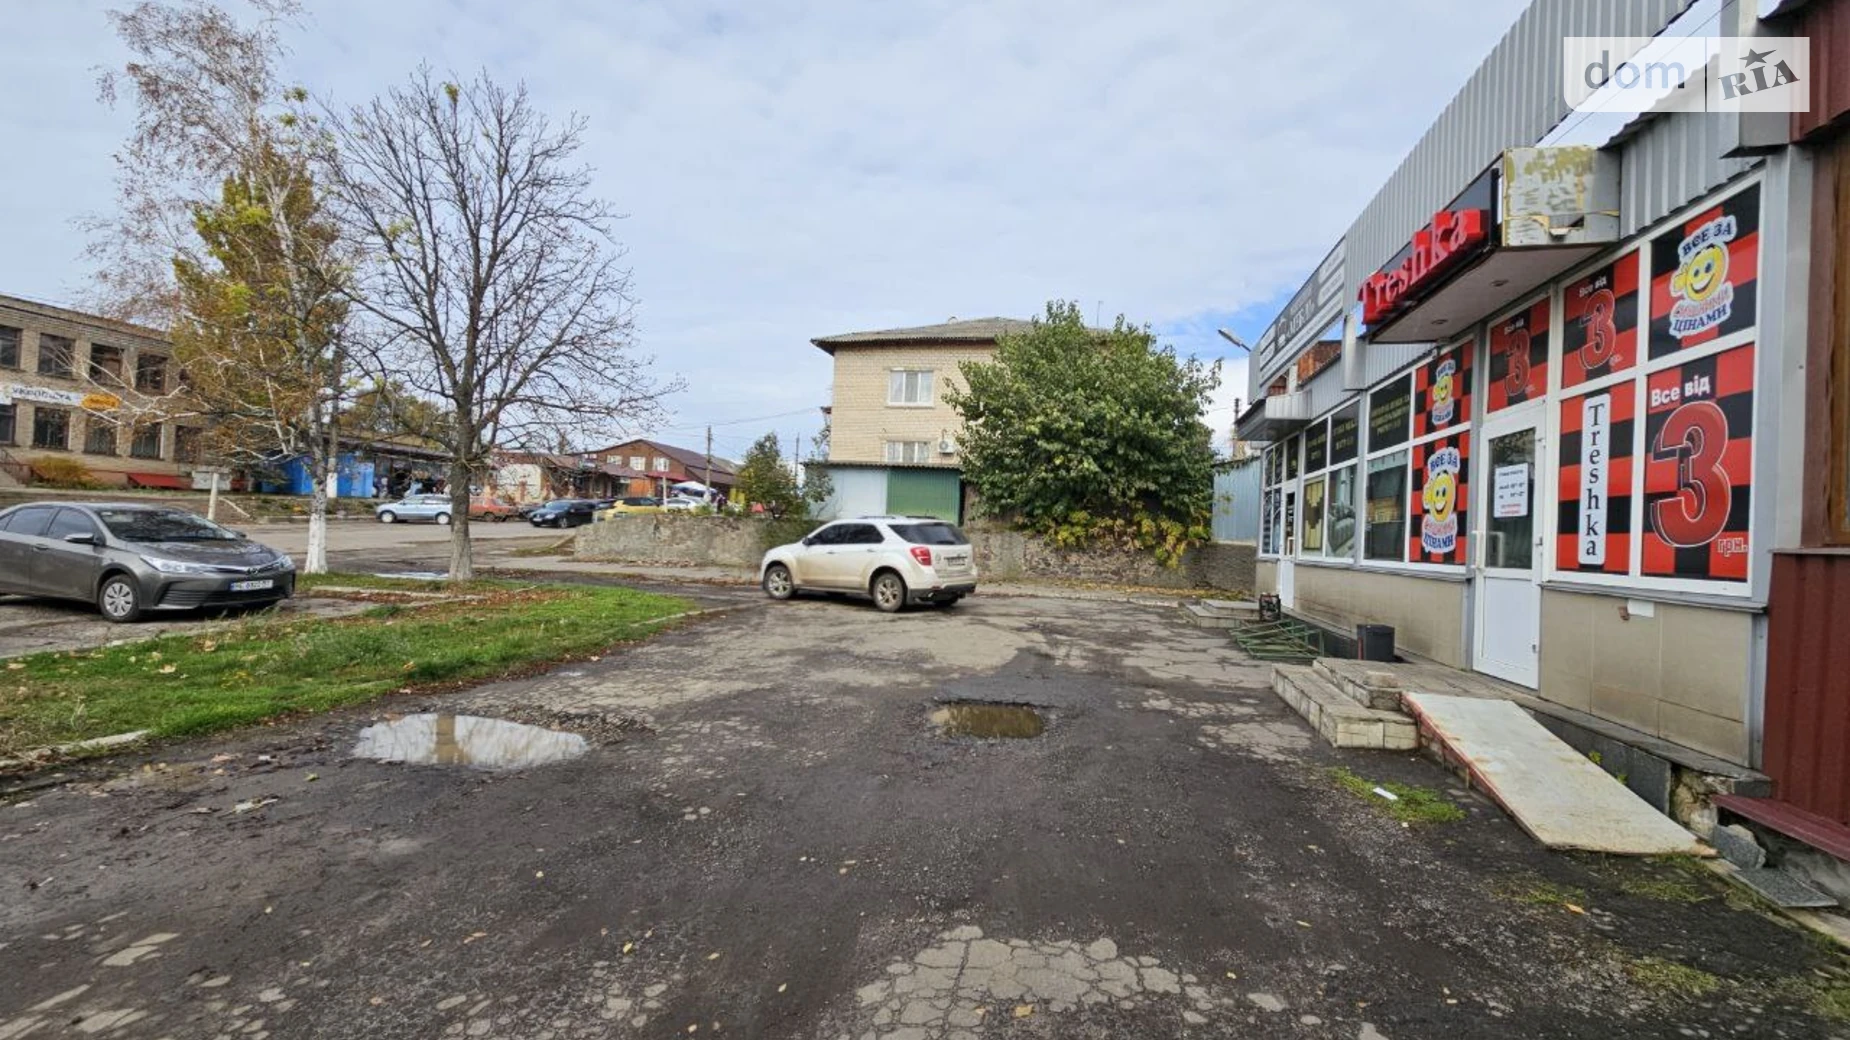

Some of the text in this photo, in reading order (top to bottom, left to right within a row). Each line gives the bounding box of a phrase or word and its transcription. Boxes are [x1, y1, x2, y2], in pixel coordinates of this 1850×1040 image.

[1682, 221, 1732, 256] ВСЕ ЗА
[1357, 208, 1487, 325] Treshka
[1580, 289, 1617, 369] 3
[1673, 304, 1728, 334] ЦІНАМИ
[1506, 328, 1530, 396] 3
[1651, 375, 1711, 408] Все від
[1430, 451, 1458, 473] ВСЕ ЗА
[1586, 403, 1605, 556] Treshka
[1651, 400, 1732, 548] 3
[1717, 537, 1749, 557] грн.
